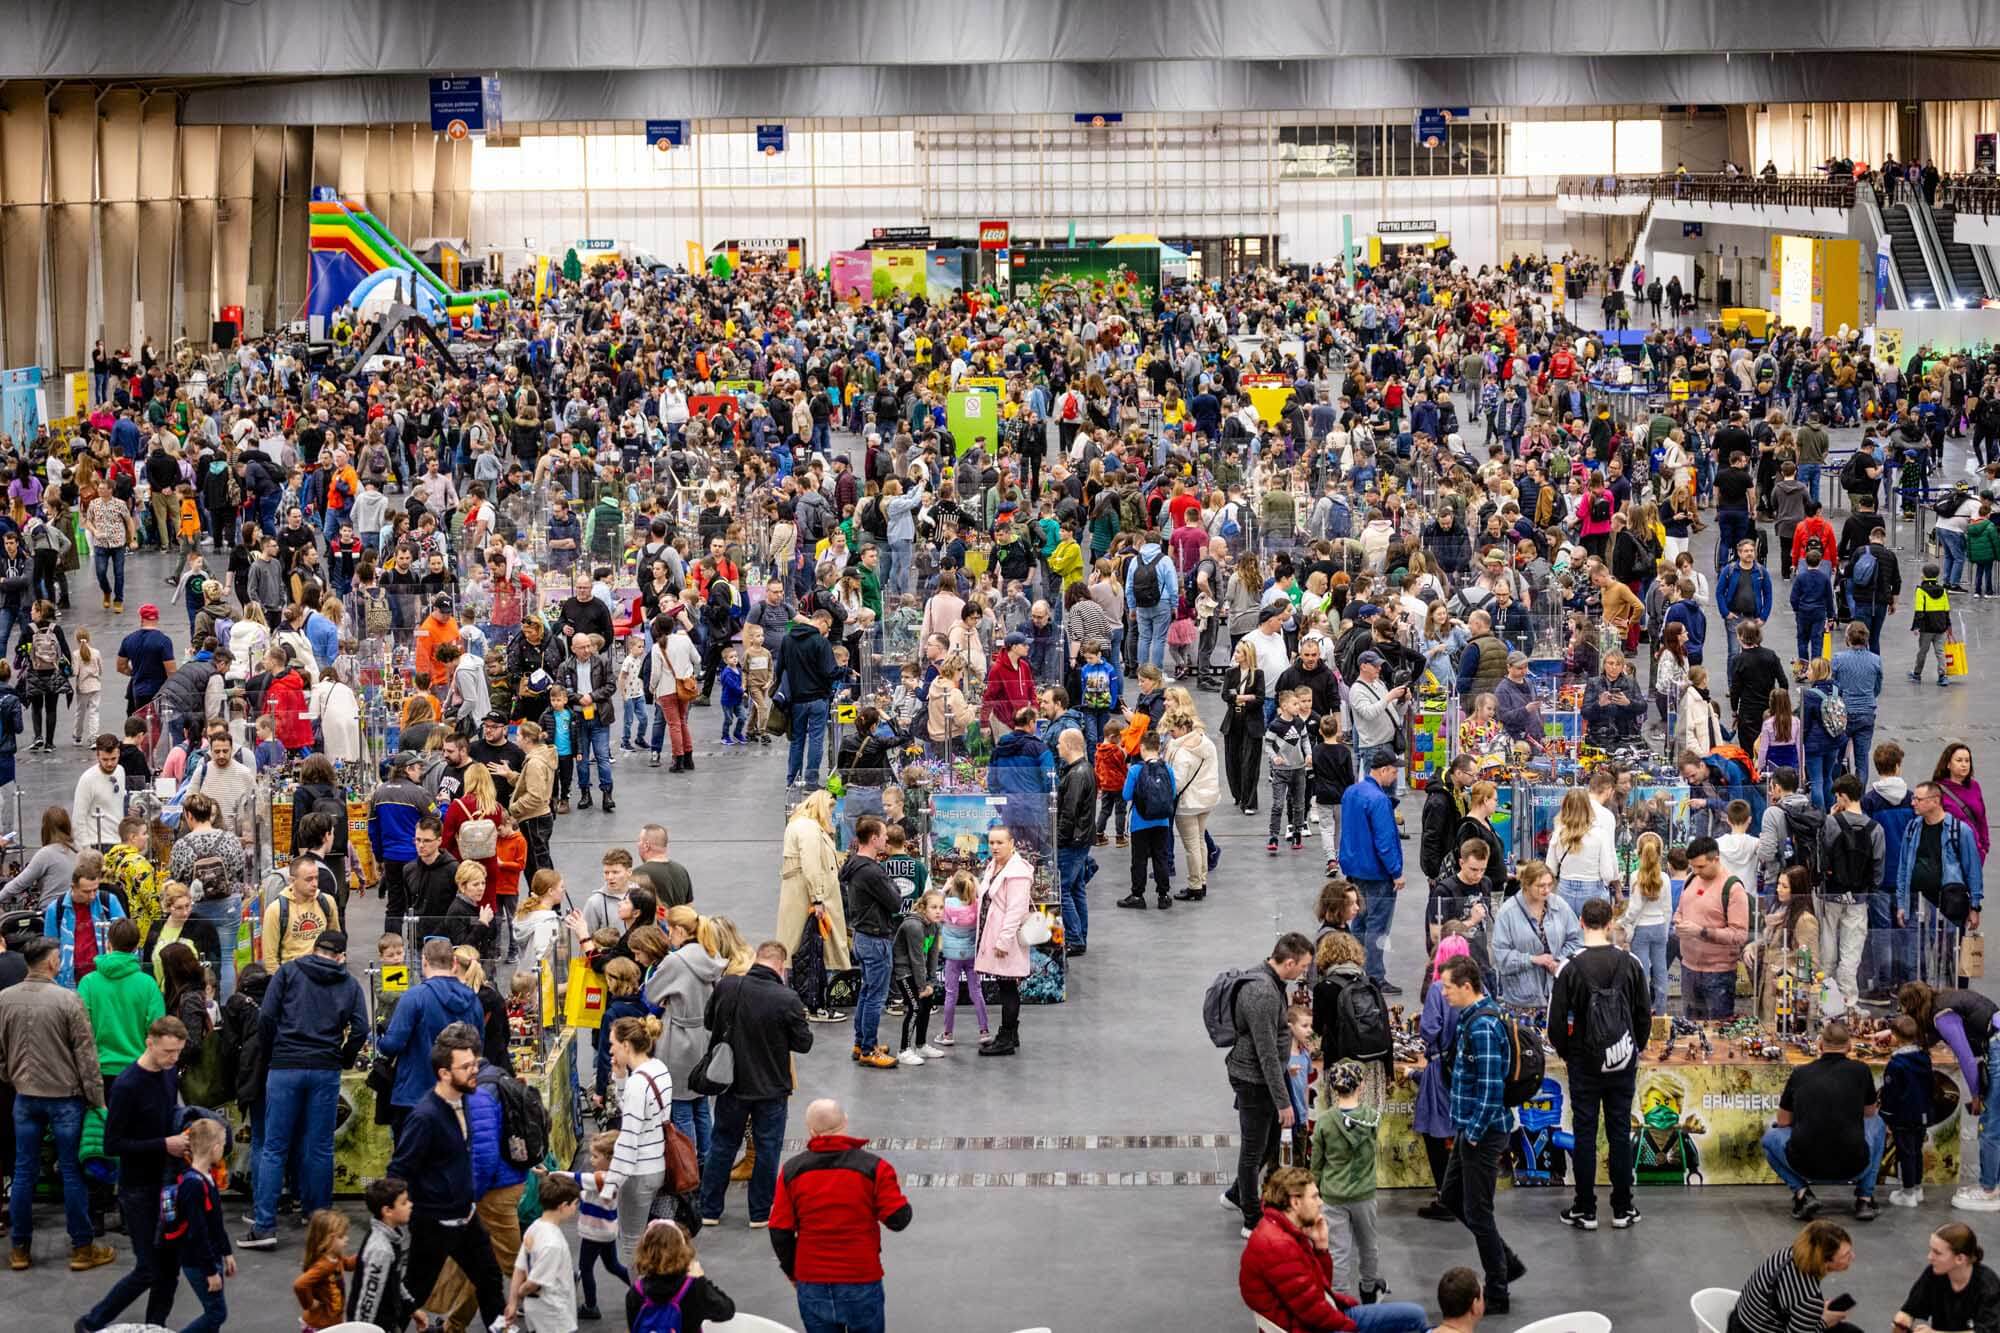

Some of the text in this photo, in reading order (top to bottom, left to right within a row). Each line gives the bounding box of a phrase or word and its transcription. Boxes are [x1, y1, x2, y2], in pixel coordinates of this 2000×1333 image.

[442, 80, 451, 91] D
[983, 229, 1006, 241] LEGO
[884, 860, 916, 877] NICE
[1605, 1029, 1634, 1067] NIKE
